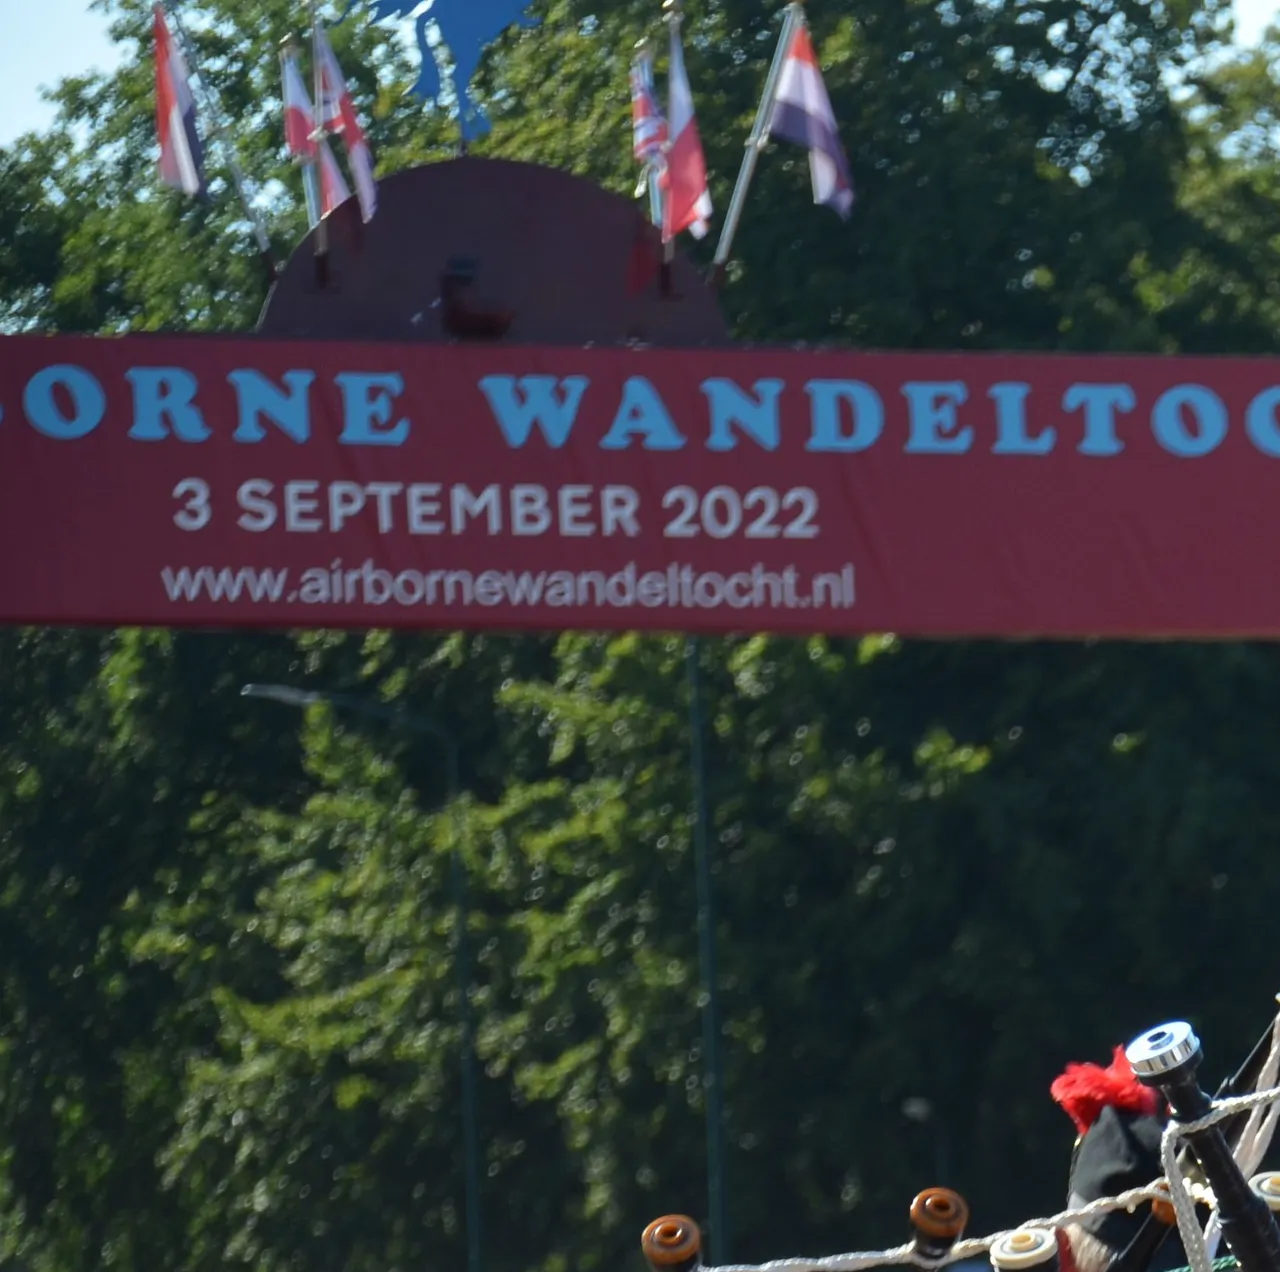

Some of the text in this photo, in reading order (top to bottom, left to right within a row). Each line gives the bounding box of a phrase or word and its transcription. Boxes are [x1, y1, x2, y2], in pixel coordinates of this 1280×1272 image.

[0, 363, 411, 447] ORNE
[171, 476, 821, 540] 3 SEPTEMBER 2022
[160, 556, 857, 609] www.airbornewandeltocht.nl
